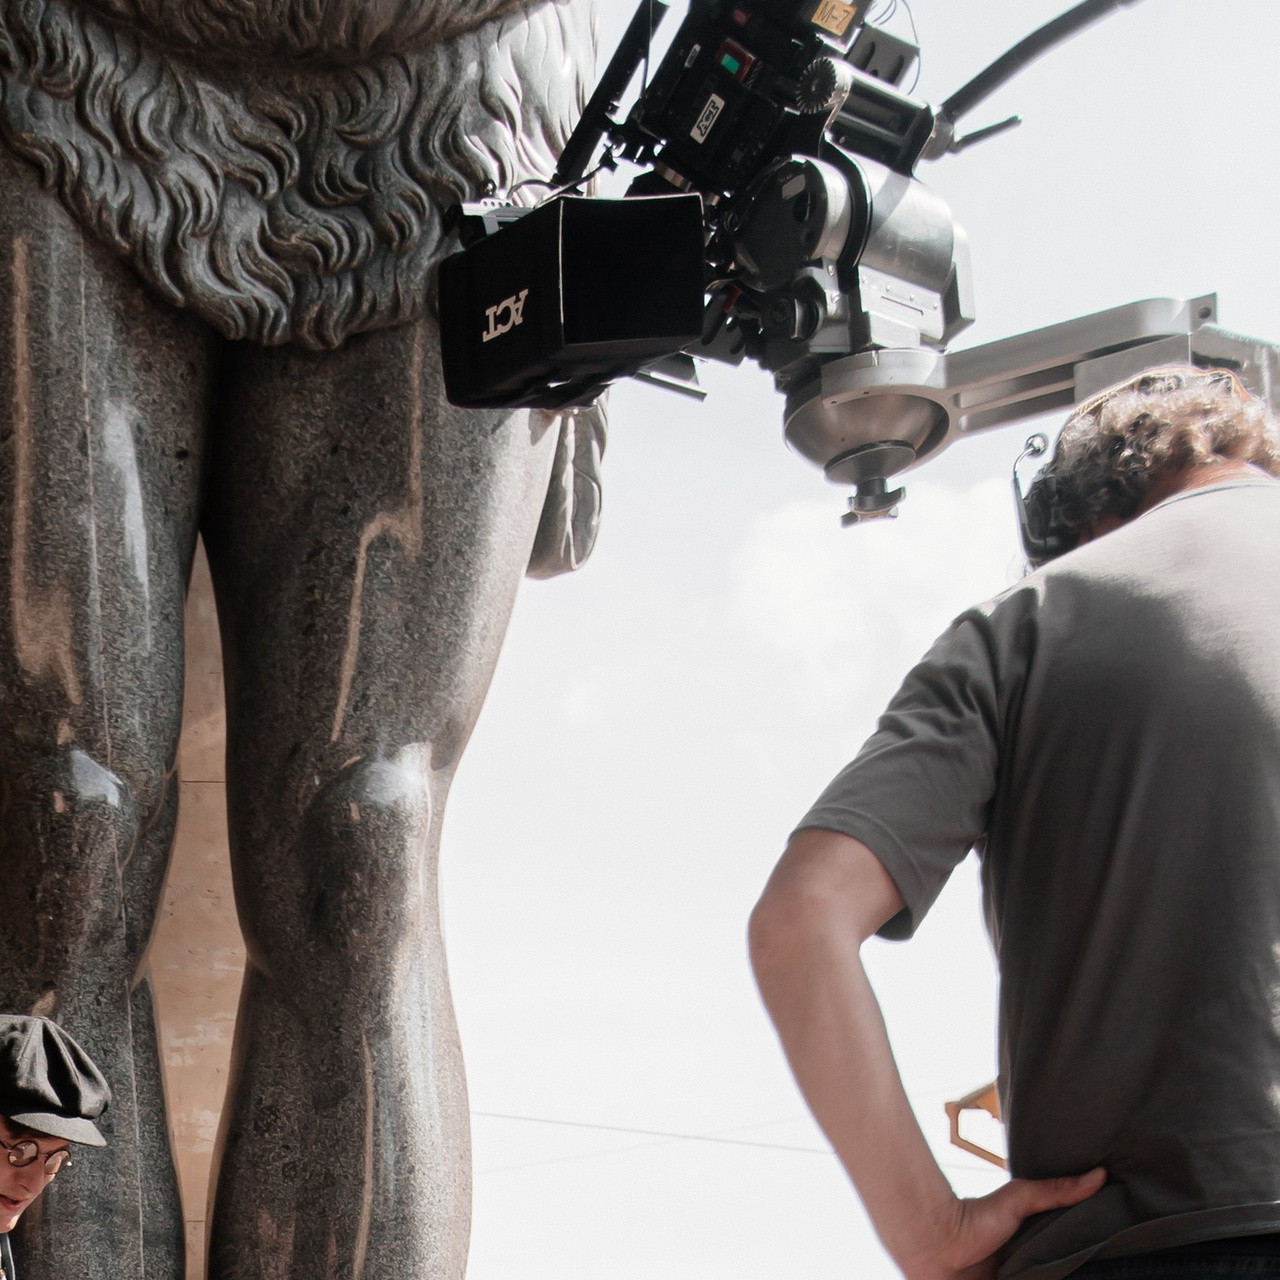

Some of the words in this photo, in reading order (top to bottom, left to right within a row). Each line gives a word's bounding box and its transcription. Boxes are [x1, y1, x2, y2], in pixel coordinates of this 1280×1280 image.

[817, 0, 850, 29] M-7
[695, 100, 720, 137] ACT
[482, 288, 529, 343] ACT
